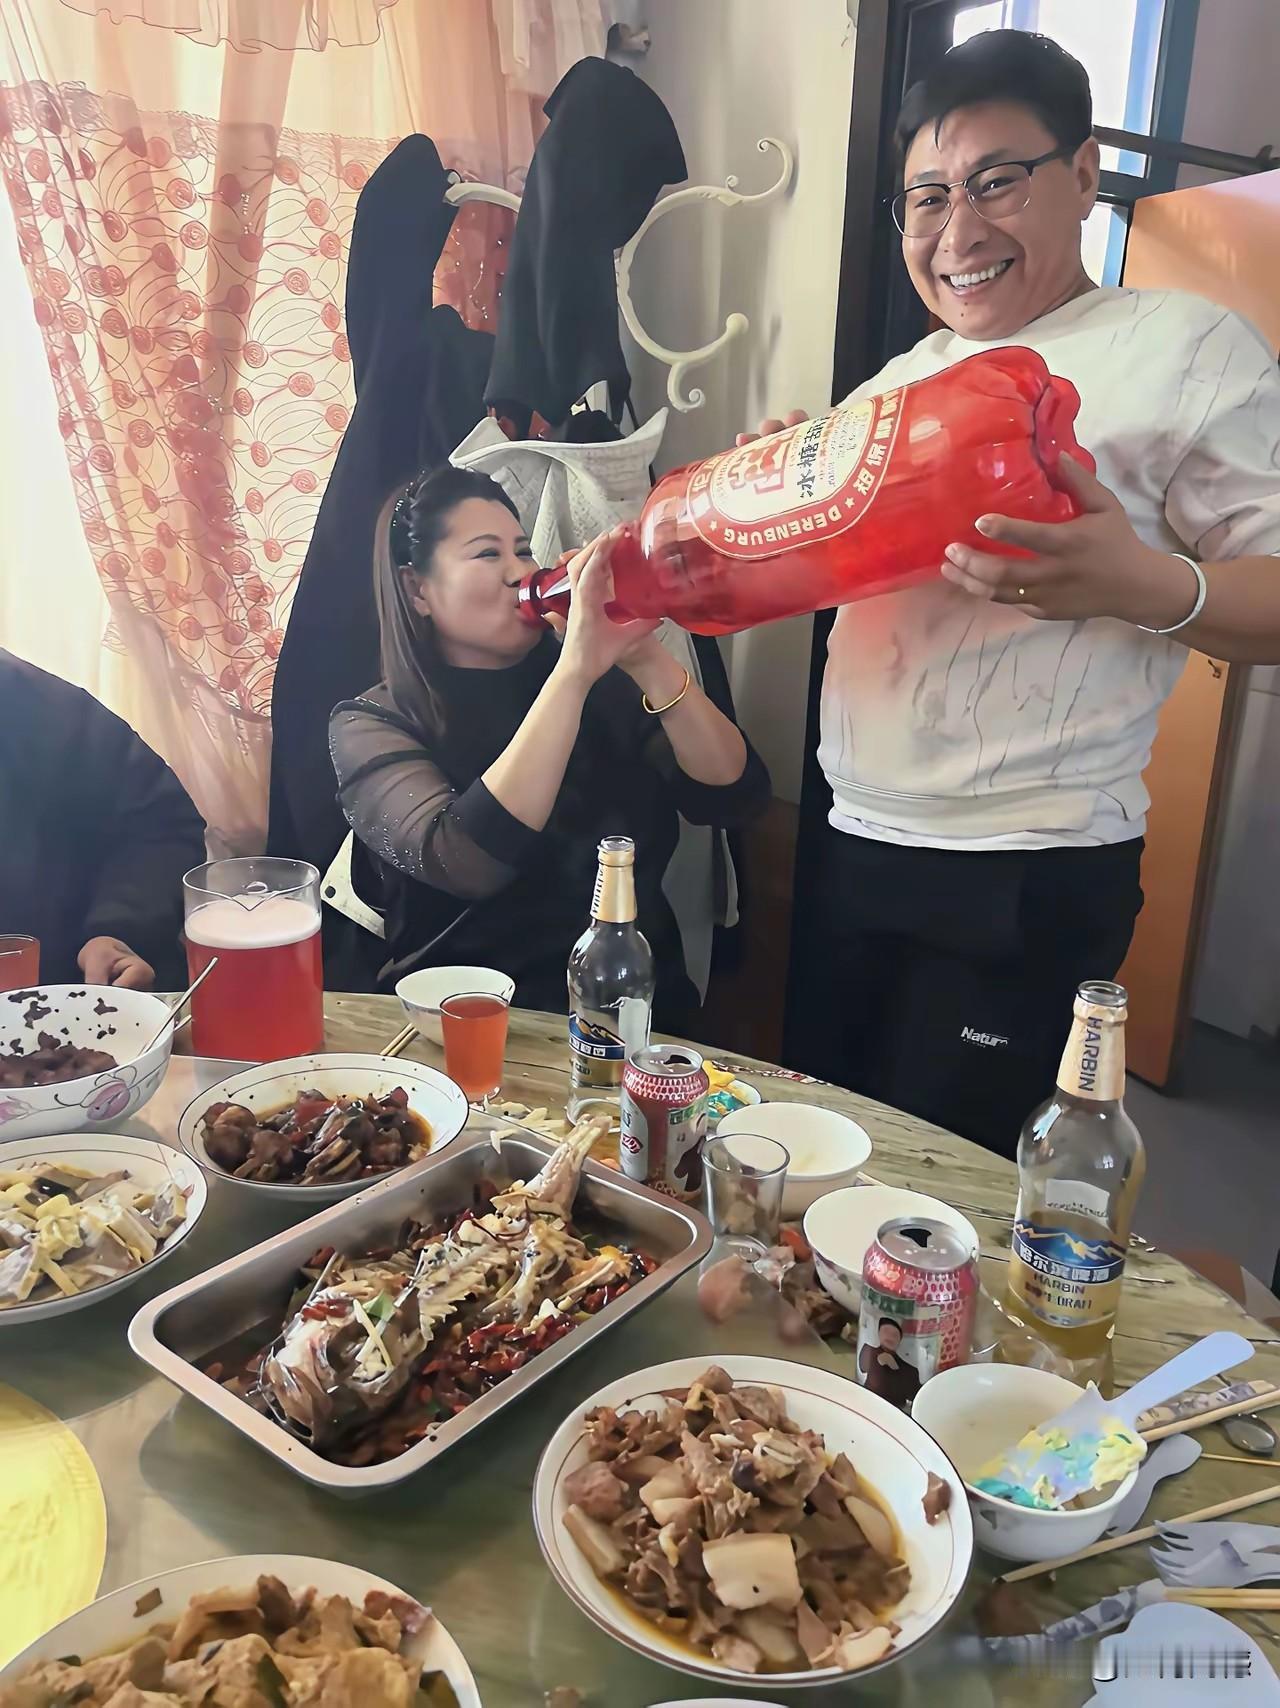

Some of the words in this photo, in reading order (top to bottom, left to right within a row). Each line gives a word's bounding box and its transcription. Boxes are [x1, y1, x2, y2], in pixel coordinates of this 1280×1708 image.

[796, 416, 832, 498] 冰糖葫
[724, 505, 842, 546] DERENBURG
[1078, 1016, 1103, 1091] HARBIN
[1034, 1273, 1085, 1294] HARBIN
